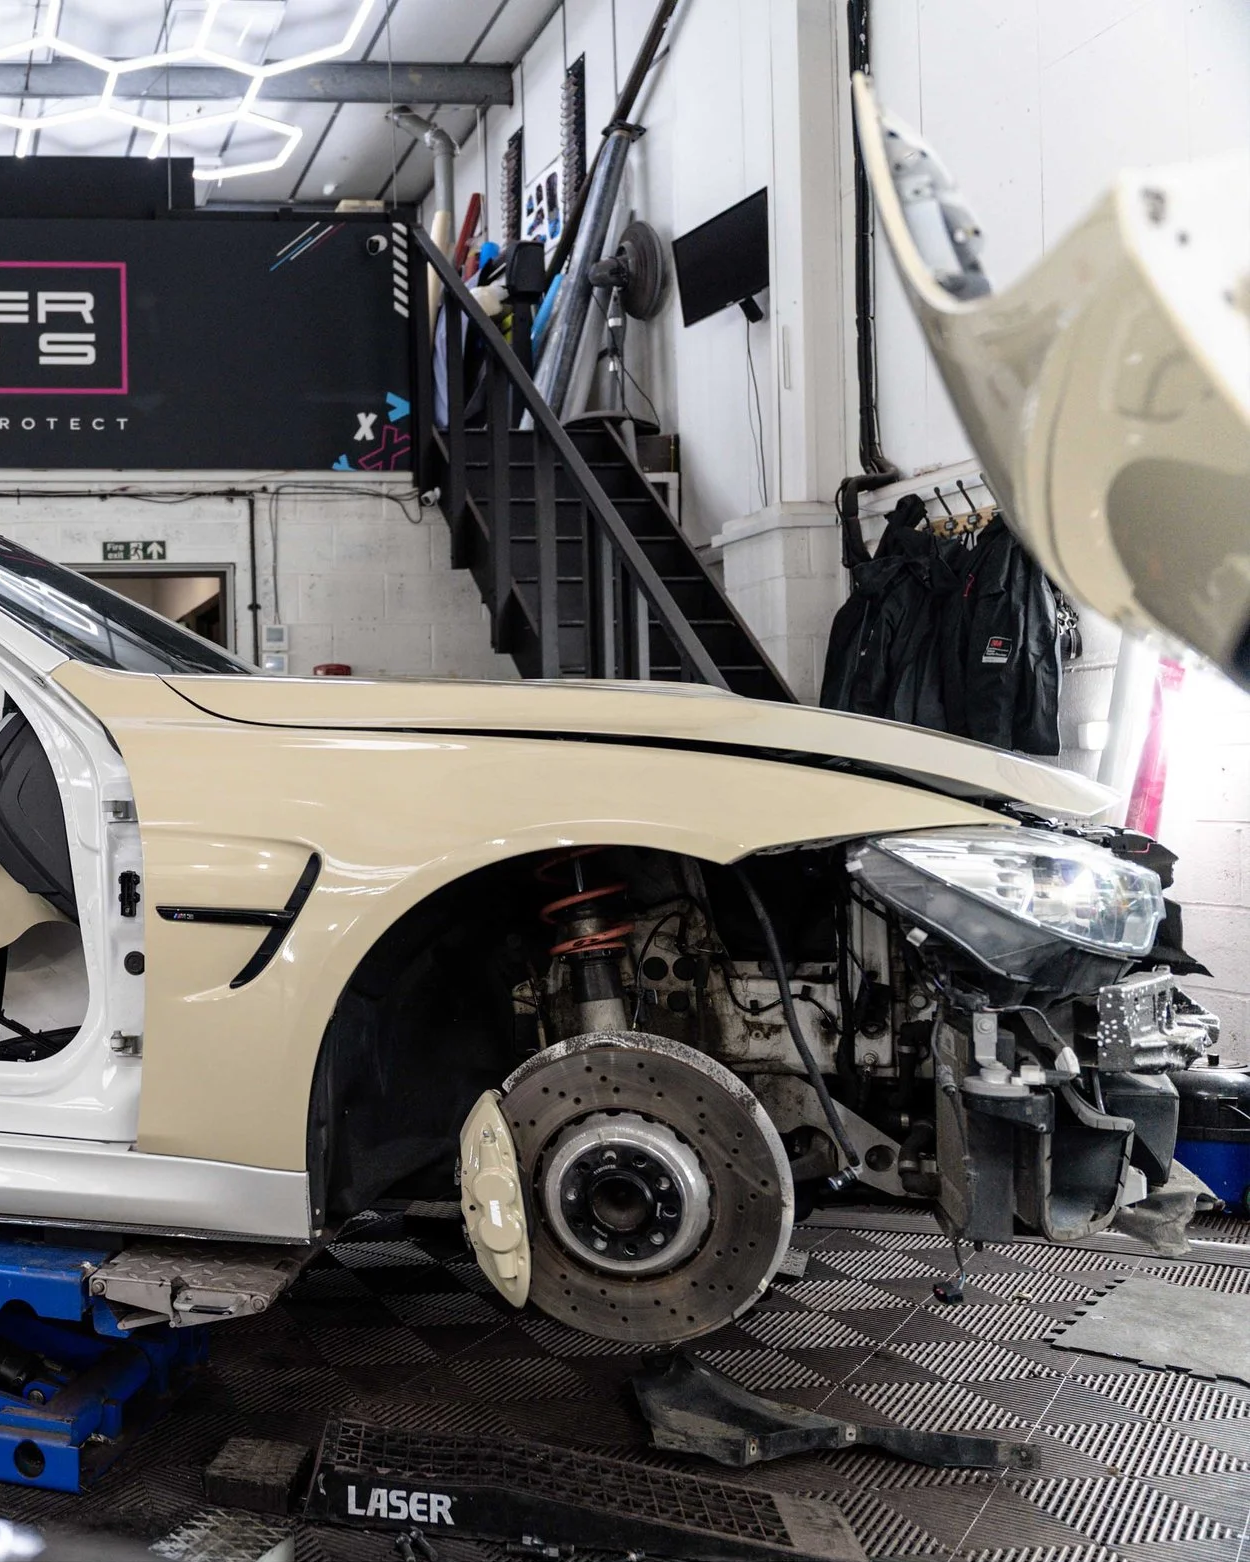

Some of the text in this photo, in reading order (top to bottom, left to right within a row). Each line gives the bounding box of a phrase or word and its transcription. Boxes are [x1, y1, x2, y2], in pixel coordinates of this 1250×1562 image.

[106, 543, 125, 551] Fire
[107, 552, 124, 560] exit
[347, 1485, 456, 1525] LASER
